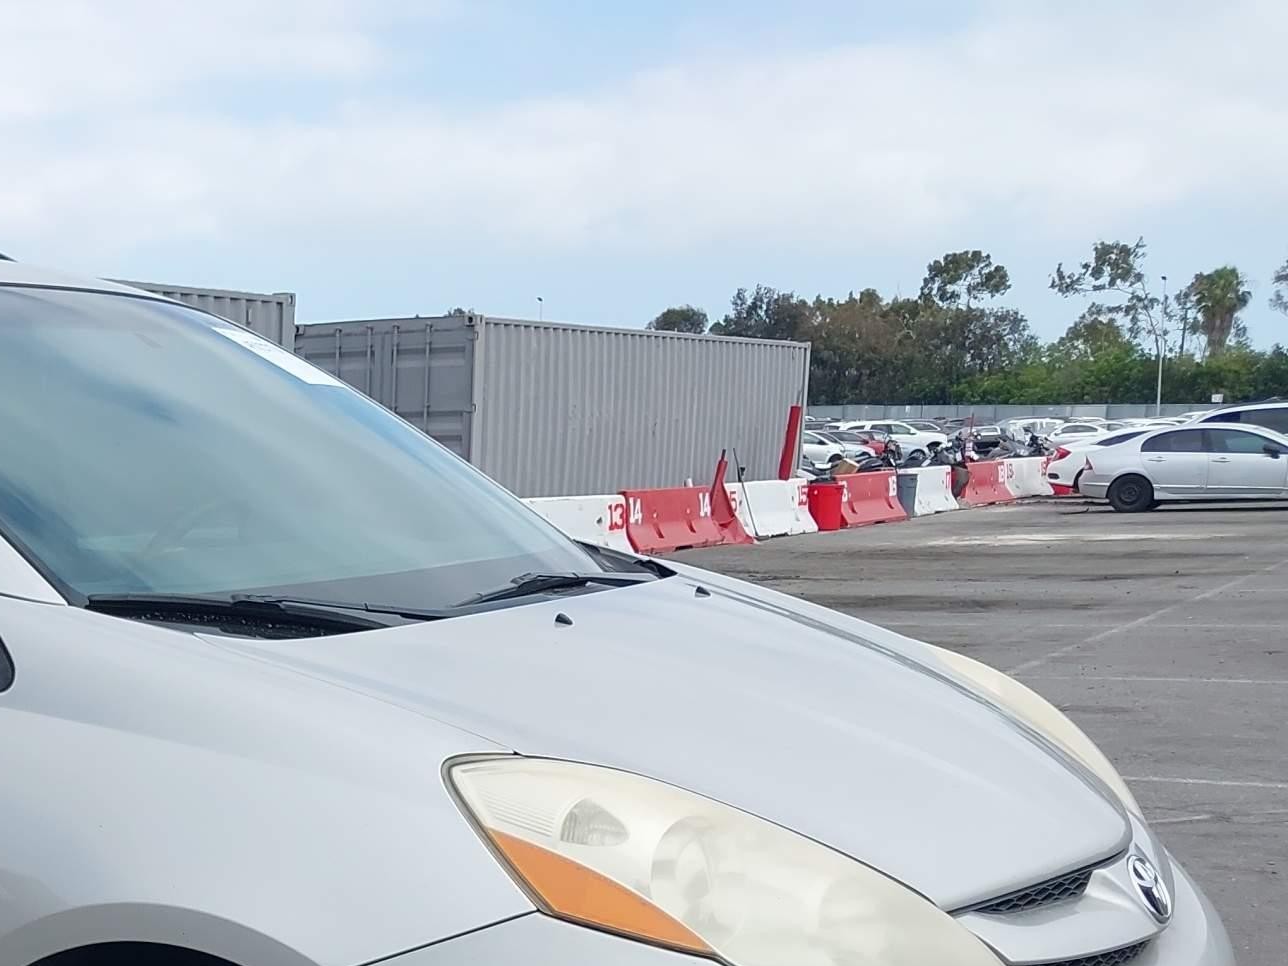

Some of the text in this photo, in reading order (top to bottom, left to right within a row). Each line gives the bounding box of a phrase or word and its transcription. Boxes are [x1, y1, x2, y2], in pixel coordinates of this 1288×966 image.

[608, 503, 625, 531] 13
[629, 496, 643, 525] 14
[699, 492, 711, 517] 14
